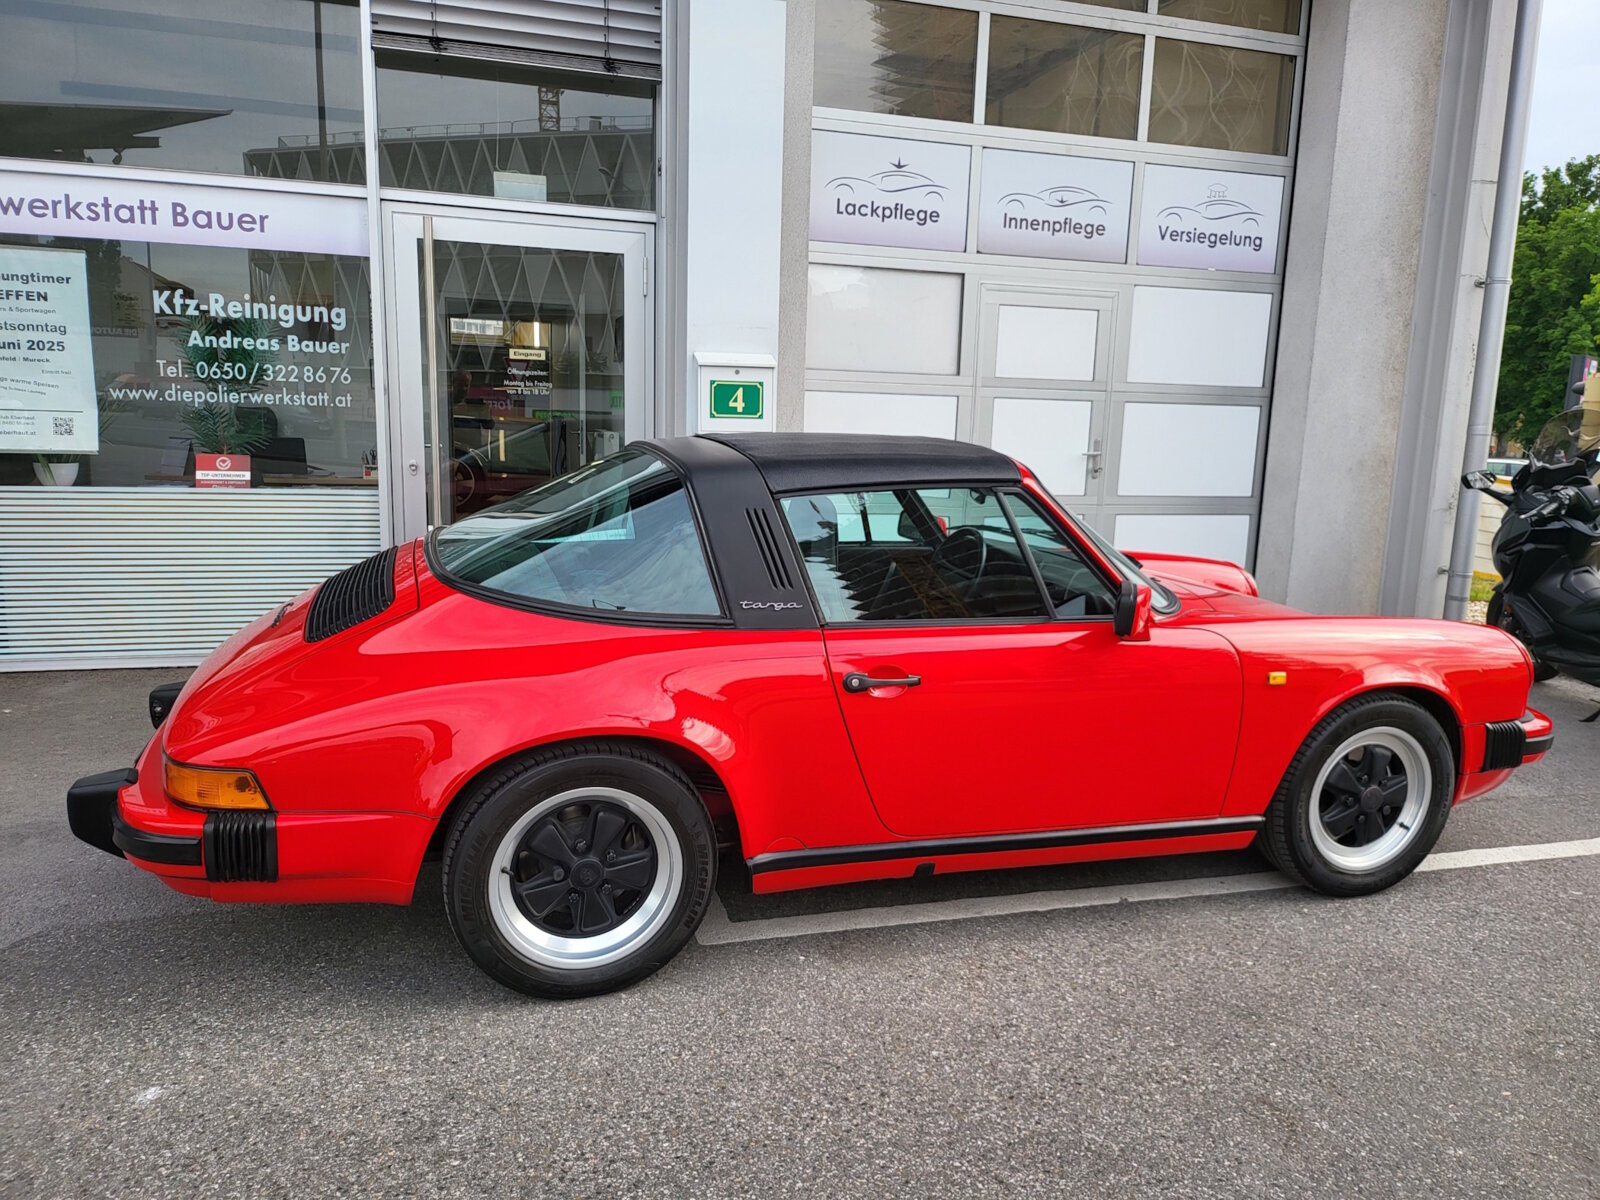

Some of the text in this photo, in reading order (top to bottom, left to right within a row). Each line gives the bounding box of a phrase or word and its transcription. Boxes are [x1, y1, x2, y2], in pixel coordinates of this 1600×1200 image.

[0, 193, 270, 234] werkstatt Bauer
[836, 198, 941, 227] Lackpflege
[1003, 212, 1107, 240] Innenpflege
[1158, 224, 1263, 252] Versiegelung
[152, 288, 348, 331] Kfz-Reinigung
[26, 339, 66, 352] 2025
[187, 330, 350, 355] Andreas Bauer
[155, 359, 189, 378] Tel.
[109, 383, 353, 408] www.diepolierwerkstatt.at
[503, 379, 525, 388] Montag
[535, 381, 553, 389] Freitag
[728, 386, 745, 413] 4
[740, 600, 803, 611] targa
